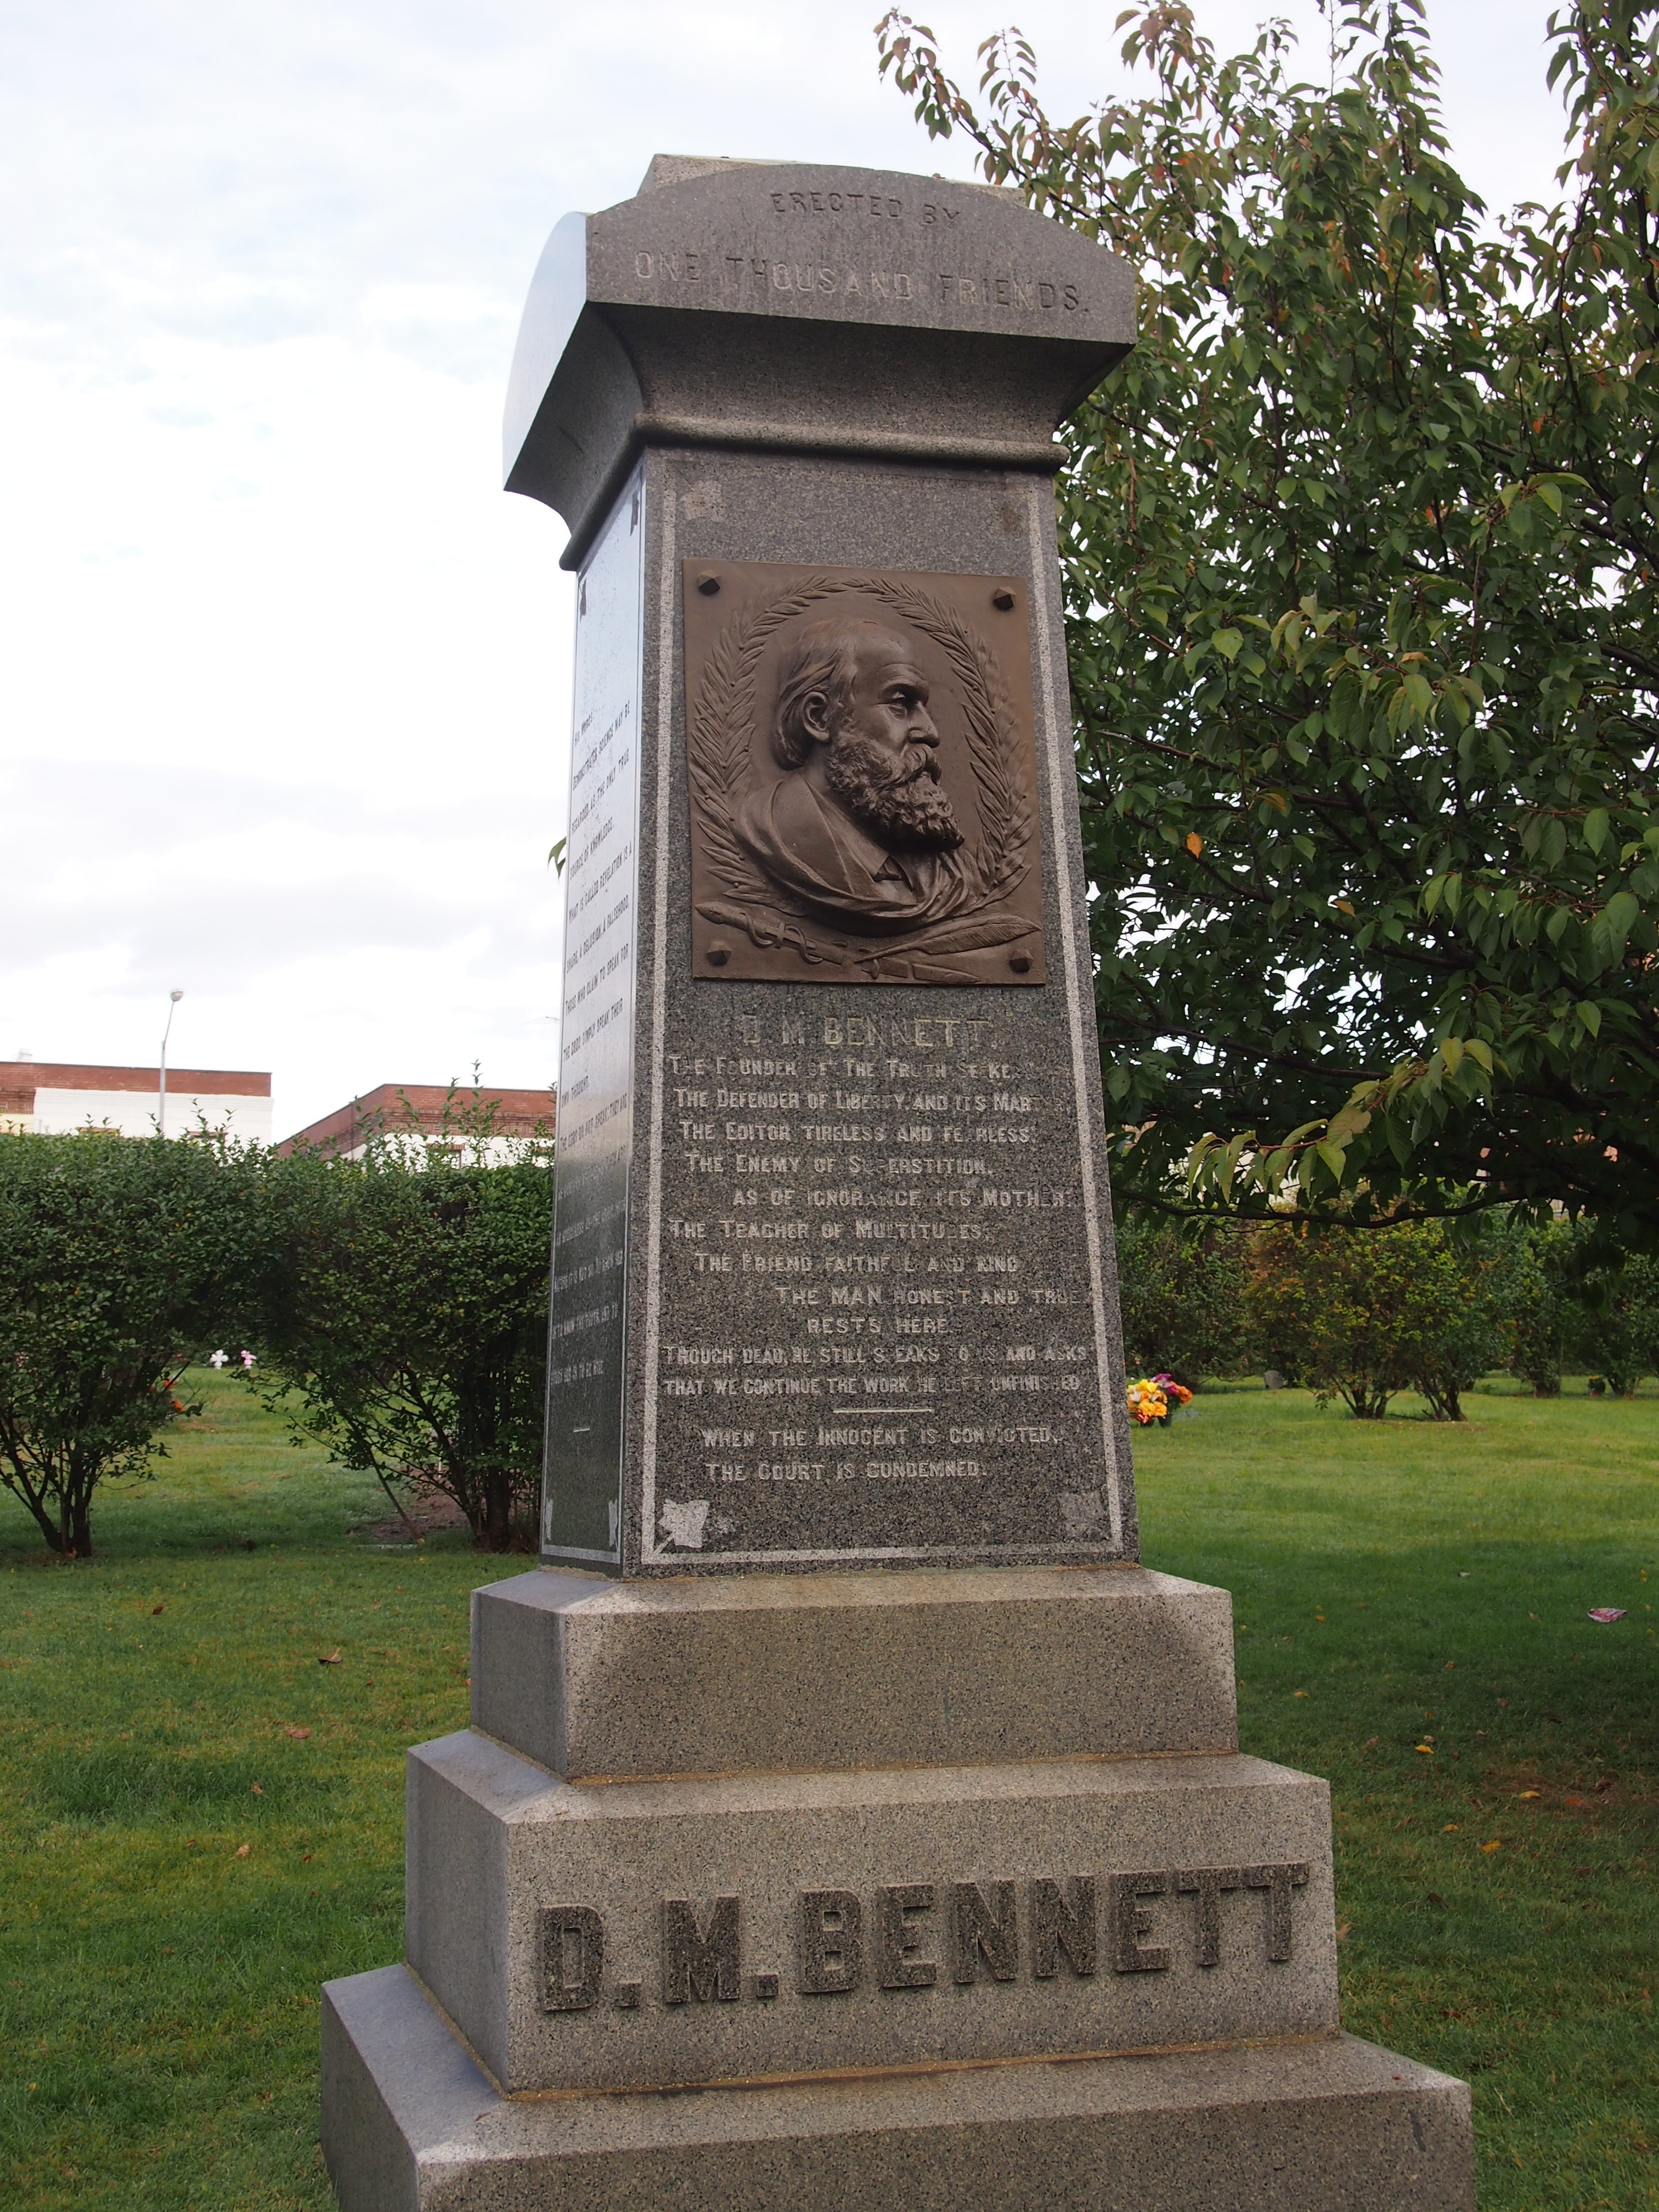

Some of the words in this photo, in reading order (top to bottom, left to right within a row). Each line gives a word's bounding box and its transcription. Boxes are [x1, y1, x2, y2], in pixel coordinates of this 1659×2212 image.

[772, 193, 903, 219] ERECTED
[923, 202, 962, 225] BY
[634, 250, 699, 281] ONE
[724, 255, 913, 301] THOUSAND
[939, 274, 1089, 313] FRIENDS.
[599, 723, 613, 754] SCIENCE
[614, 709, 623, 732] MAY
[624, 699, 630, 718] BE
[590, 793, 595, 810] AS
[606, 765, 616, 789] ONLY
[618, 748, 629, 773] TRUE
[569, 853, 583, 880] SOURCE
[584, 846, 588, 862] OF
[590, 816, 614, 855] KNOWLEDGE.
[568, 901, 578, 924] WHAT
[579, 896, 583, 912] IS
[585, 879, 599, 905] CALLED
[599, 851, 622, 889] REVELATION
[623, 845, 627, 862] IS
[629, 839, 631, 856] A
[579, 944, 582, 958] A
[603, 917, 606, 933] A
[565, 992, 576, 1016] THOSE
[577, 985, 585, 1004] WHO
[586, 972, 598, 995] CLAIM
[599, 965, 605, 983] TO
[607, 952, 619, 975] SPEAK
[620, 943, 629, 962] FOR
[571, 1035, 580, 1055] GODS
[582, 1022, 595, 1046] SIMPLY
[597, 1009, 609, 1032] SPEAK
[611, 997, 623, 1020] THEIR
[669, 1055, 705, 1075] THE
[716, 1056, 797, 1076] FOUNDER
[808, 1061, 828, 1076] OF
[843, 1058, 876, 1077] THE
[886, 1059, 947, 1079] TRUTH
[673, 1086, 709, 1108] THE
[717, 1088, 800, 1109] DEFENDER
[807, 1093, 827, 1109] OF
[912, 1094, 949, 1111] AND
[955, 1095, 987, 1112] ITS
[679, 1120, 715, 1140] THE
[726, 1121, 792, 1141] EDITOR
[802, 1125, 885, 1142] TIRELESS
[896, 1126, 933, 1142] AND
[685, 1154, 724, 1173] THE
[736, 1154, 802, 1173] ENEMY
[814, 1157, 837, 1173] OF
[732, 1189, 759, 1206] AS
[770, 1189, 796, 1206] OF
[936, 1189, 972, 1207] ITS
[669, 1218, 707, 1239] THE
[719, 1219, 810, 1239] TEACHER
[822, 1222, 844, 1239] OF
[695, 1252, 732, 1272] THE
[742, 1252, 813, 1272] FRIEND
[825, 1254, 916, 1272] FAITHFUL
[927, 1255, 966, 1272] AND
[775, 1285, 819, 1305] THE
[892, 1290, 971, 1305] HONEST
[980, 1289, 1020, 1305] AND
[807, 1318, 882, 1334] RESTS
[663, 1345, 734, 1365] THOUGH
[742, 1347, 789, 1365] DEAD,
[792, 1347, 812, 1364] HE
[820, 1347, 866, 1363] STILL
[872, 1346, 940, 1363] SEAKS
[1006, 1346, 1036, 1362] AND
[1043, 1346, 1087, 1362] ASKS
[664, 1379, 706, 1396] THAT
[714, 1379, 737, 1395] WE
[743, 1378, 821, 1395] CONTINUE
[826, 1377, 858, 1394] THE
[863, 1376, 910, 1393] WORK
[918, 1376, 936, 1393] HE
[944, 1376, 984, 1392] LEFT
[700, 1428, 757, 1448] WHEN
[769, 1430, 808, 1447] THE
[818, 1426, 909, 1447] INNOCENT
[920, 1428, 938, 1444] IS
[706, 1463, 747, 1481] THE
[758, 1462, 825, 1481] COURT
[837, 1463, 855, 1479] IS
[543, 1905, 642, 2012] D.
[663, 1895, 779, 2004] M.
[799, 1862, 1309, 1995] BENNETT
